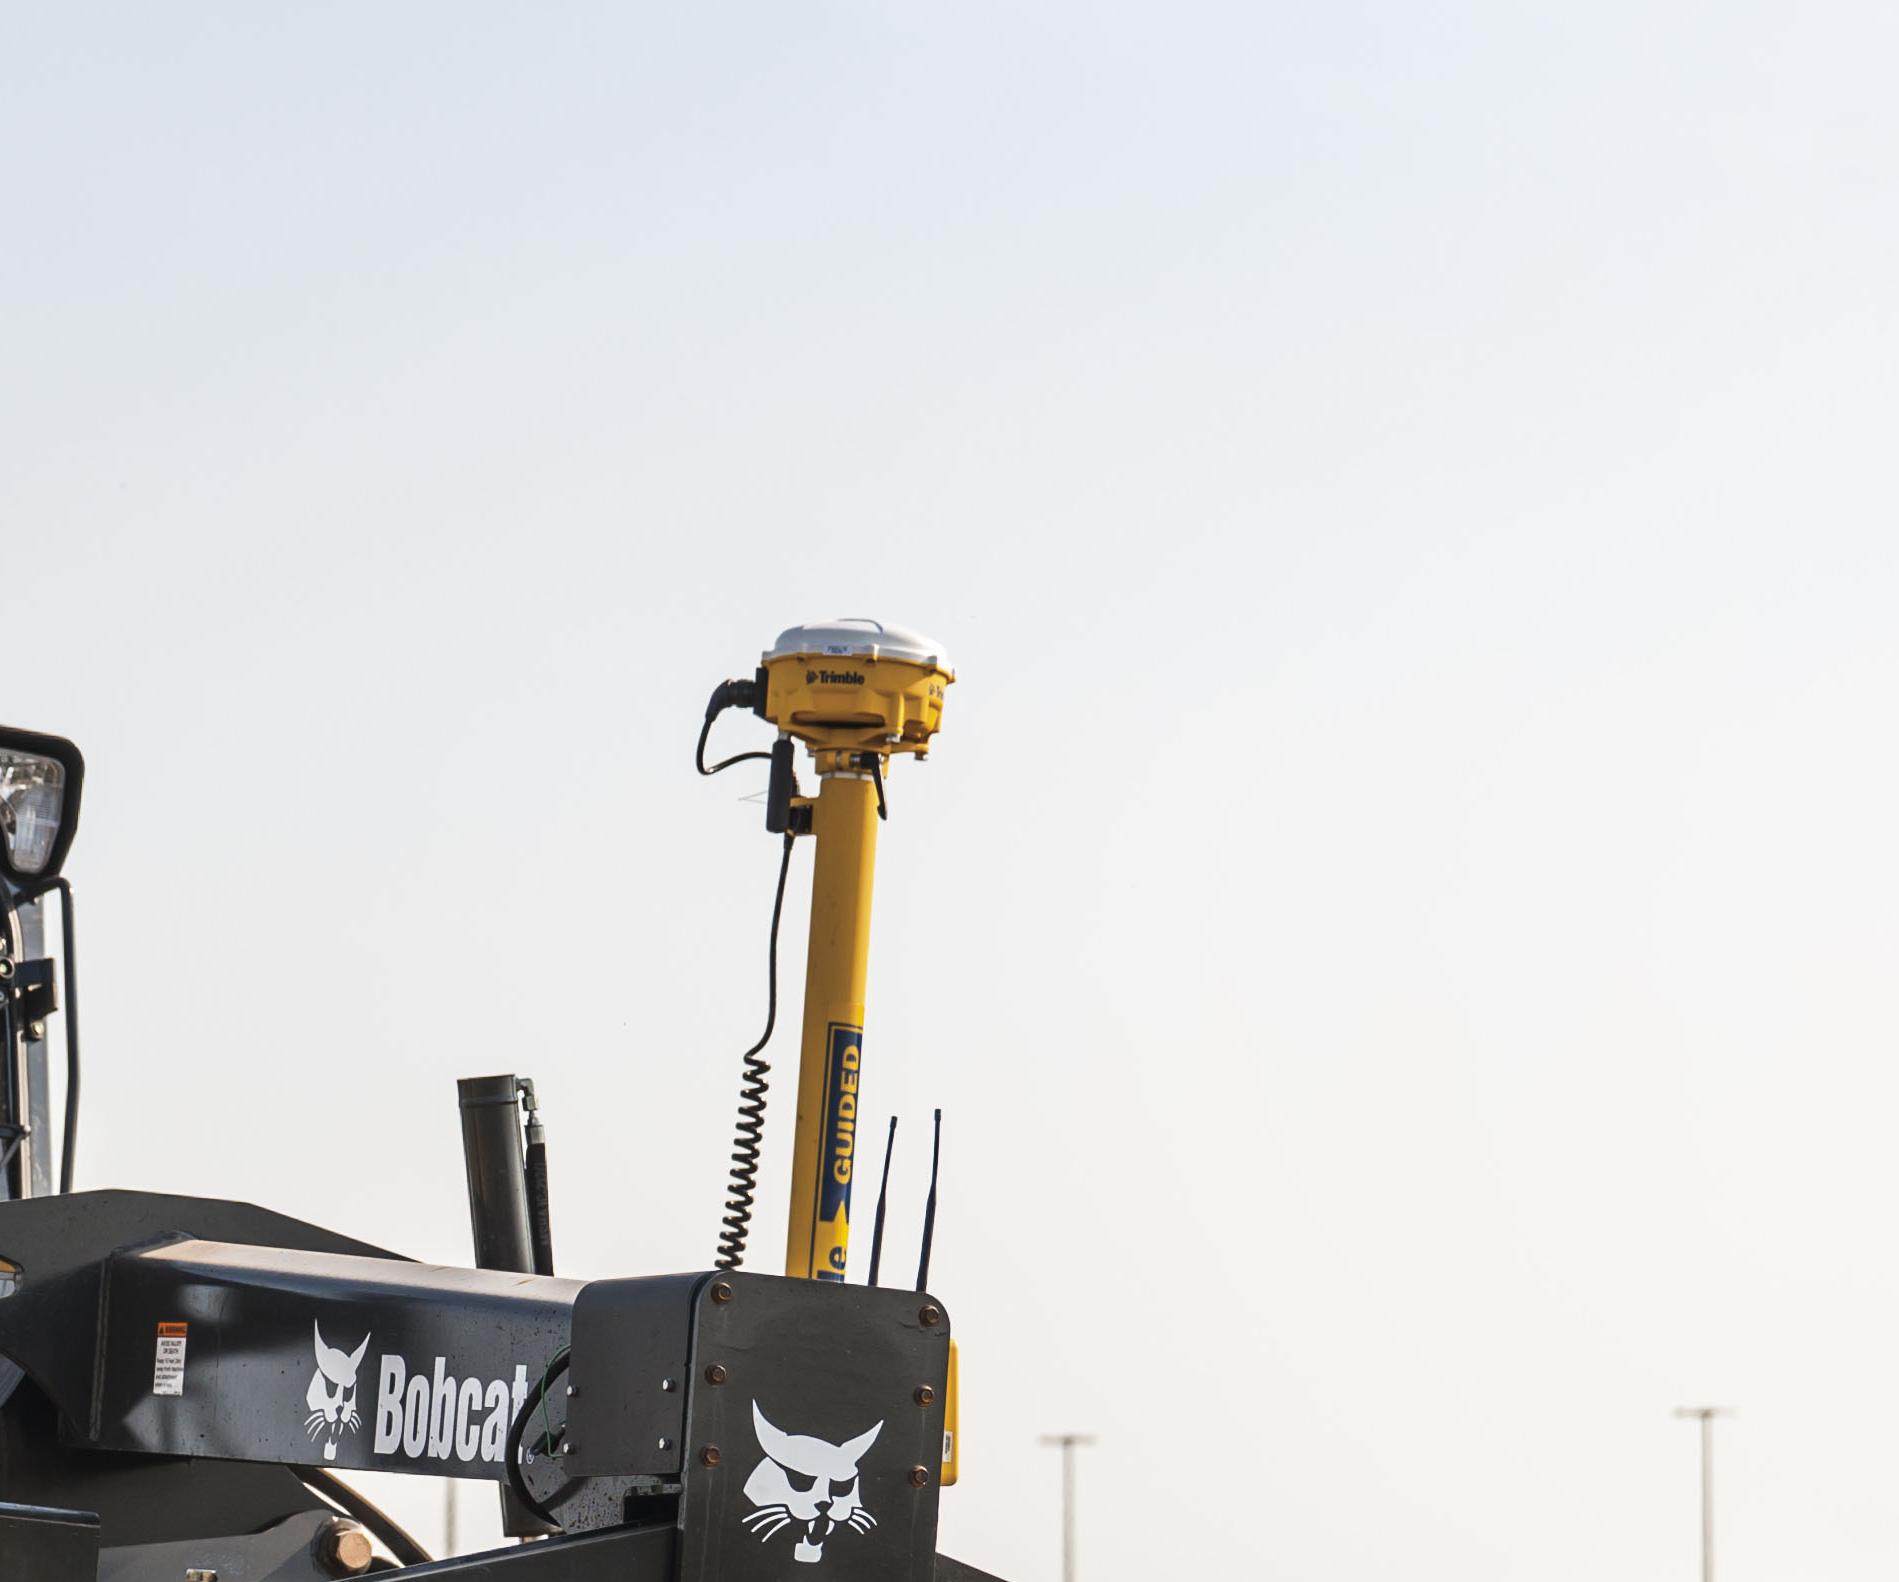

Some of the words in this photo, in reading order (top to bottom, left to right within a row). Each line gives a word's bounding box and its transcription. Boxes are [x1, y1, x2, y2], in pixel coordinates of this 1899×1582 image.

[820, 670, 865, 685] Trimble
[833, 1045, 860, 1185] GUIDED
[373, 1354, 529, 1465] Bobcat
